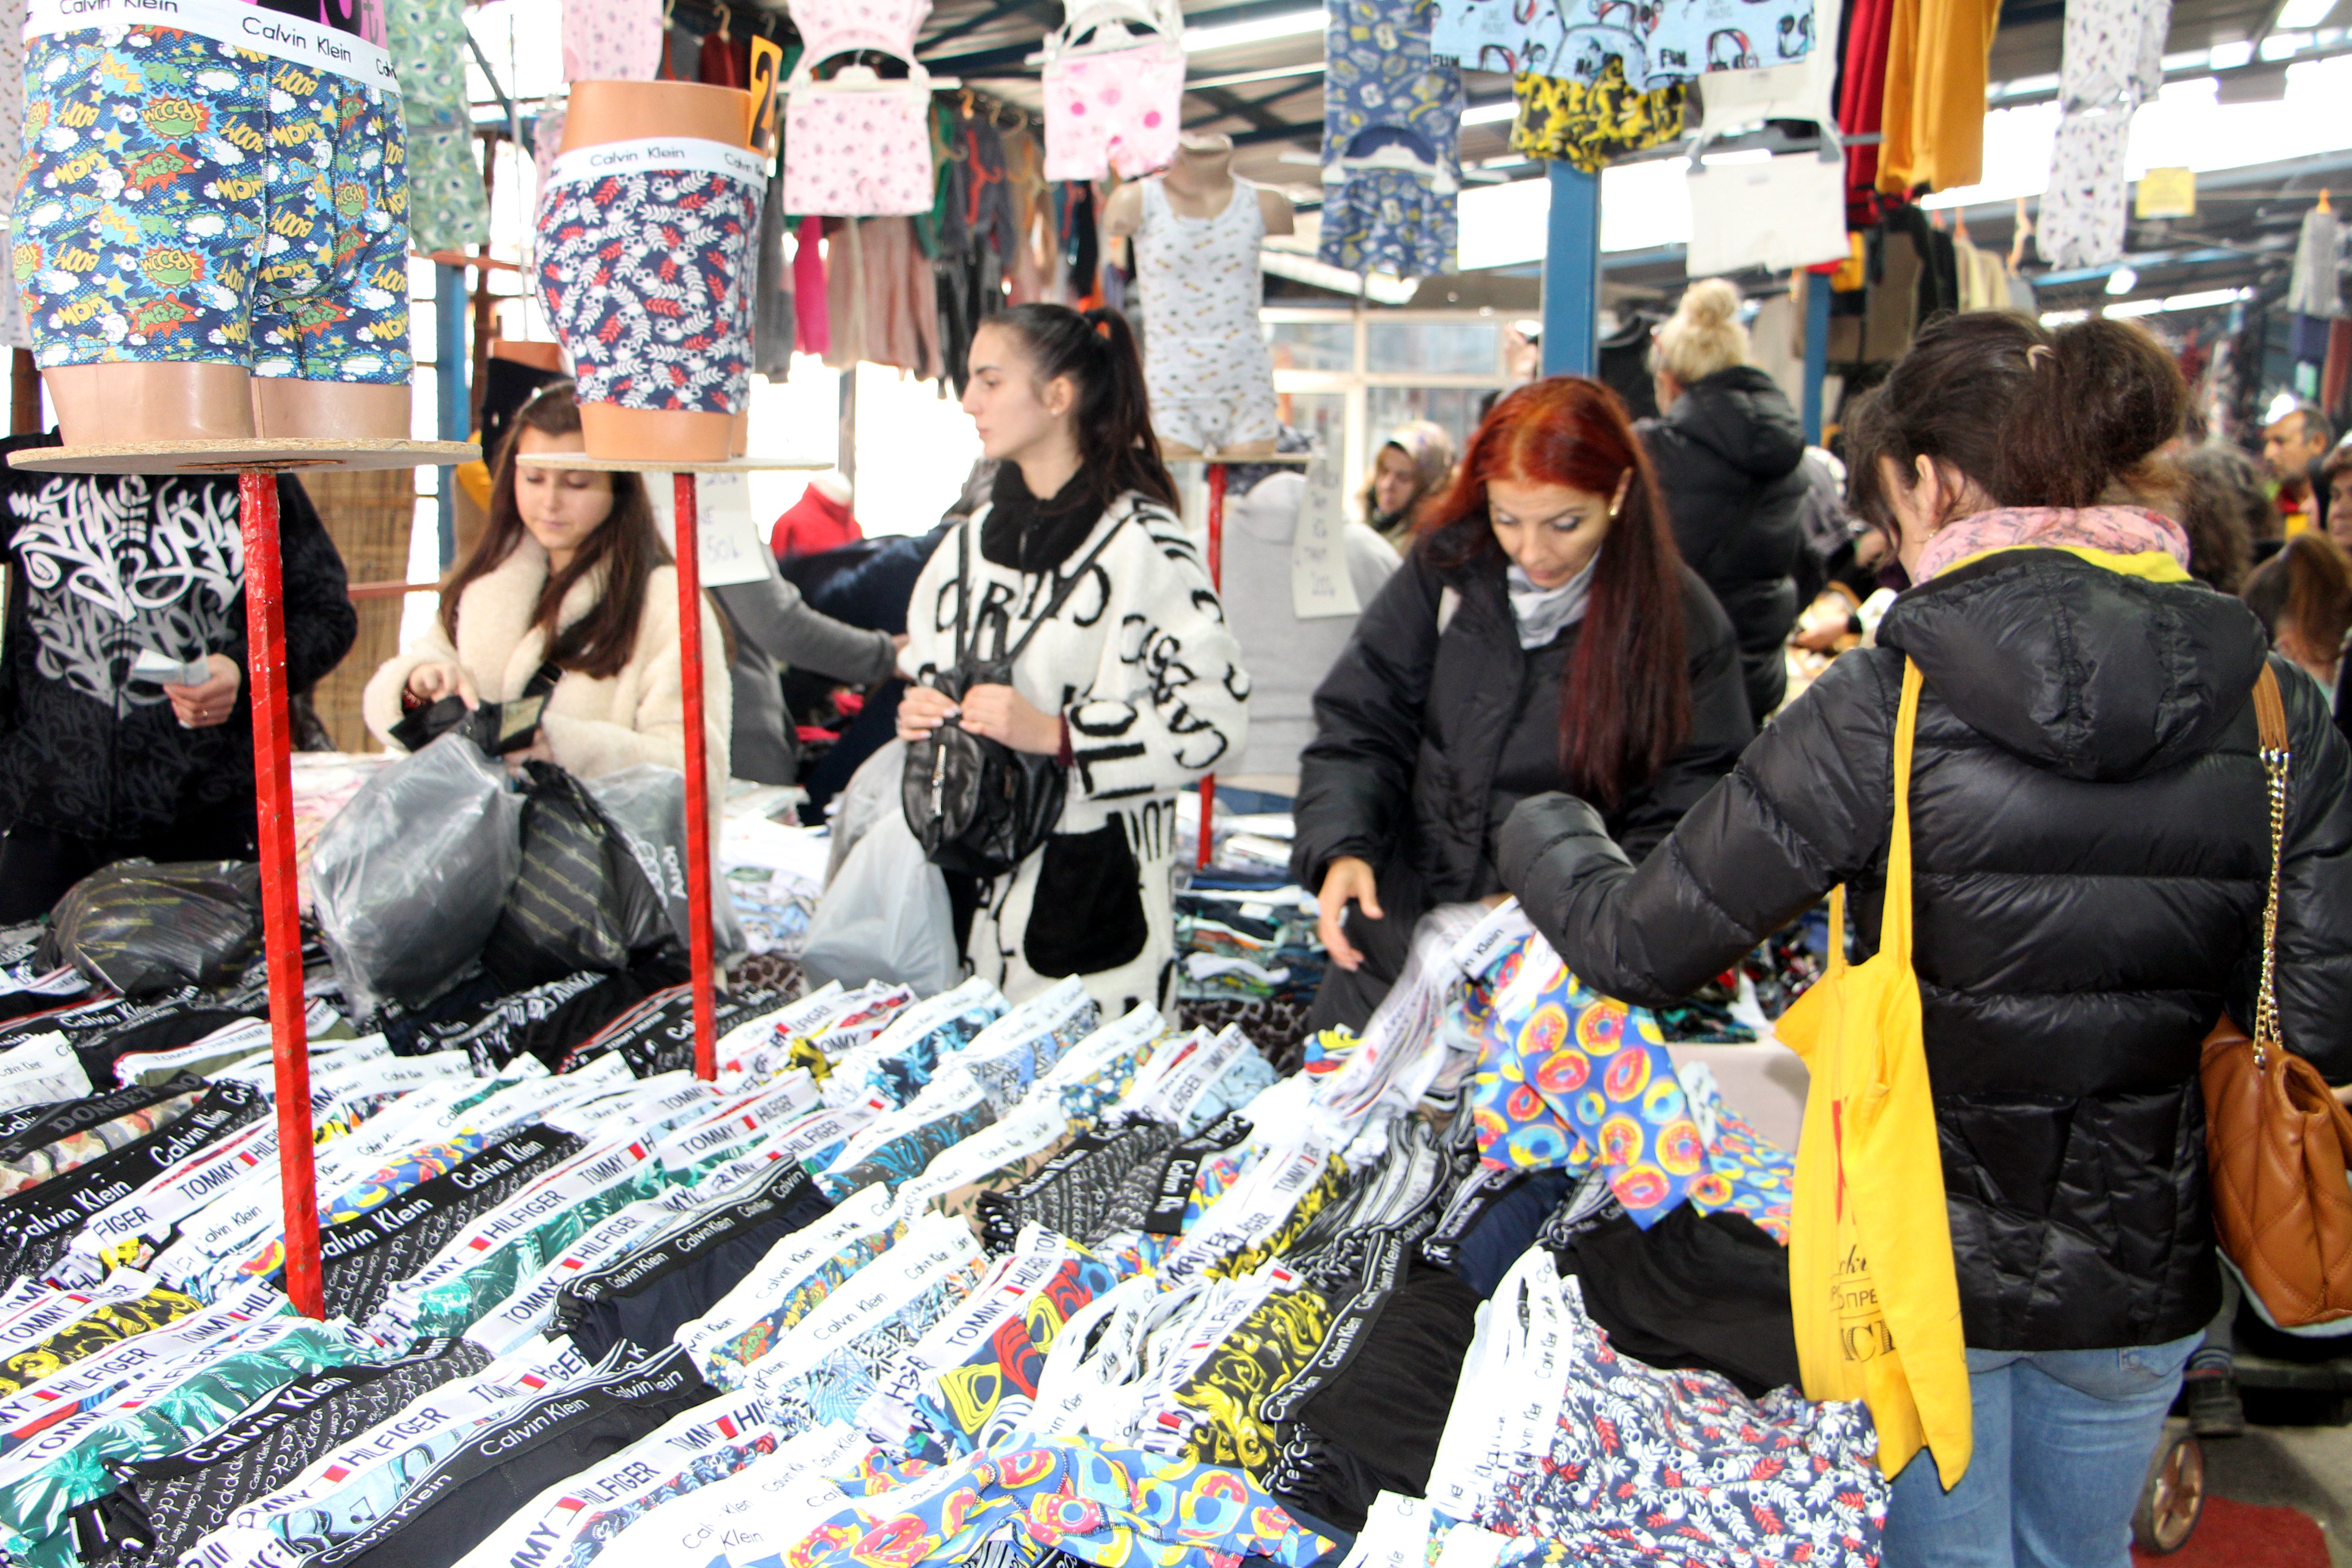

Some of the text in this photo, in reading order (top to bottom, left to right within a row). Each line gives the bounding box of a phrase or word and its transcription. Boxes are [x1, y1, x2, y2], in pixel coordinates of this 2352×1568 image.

[60, 0, 110, 14] Calvin
[242, 16, 306, 49] Calvin
[318, 35, 351, 63] Klein
[141, 99, 196, 123] BOOM
[591, 152, 638, 167] Calvin
[648, 147, 685, 159] Klein
[139, 249, 191, 274] BOOM
[1475, 927, 1505, 956] Klein
[59, 1012, 122, 1028] Calvin
[24, 1059, 44, 1071] Klein
[56, 1044, 74, 1057] Ca
[437, 1105, 459, 1129] Cal
[150, 1109, 232, 1168] Calvin Klein
[680, 1122, 738, 1156] TOMMY
[176, 1160, 241, 1201] TOMMY
[371, 1195, 433, 1234] Klein
[452, 1153, 514, 1191] Calvin
[502, 1140, 545, 1166] Klein
[1272, 1161, 1308, 1192] TOMMY
[72, 1178, 133, 1213] Klein
[482, 1190, 568, 1240] HILFIGER
[578, 1156, 628, 1188] TOMMY
[871, 1193, 897, 1217] Cal
[230, 1204, 263, 1228] Klein
[583, 1281, 603, 1302] ein
[606, 1264, 642, 1290] Calvin
[635, 1251, 670, 1276] Klein
[675, 1223, 716, 1253] Calvin
[708, 1216, 736, 1238] Klein
[771, 1170, 806, 1199] Calvin
[500, 1215, 647, 1326] TOMMY HILFIGER
[757, 1265, 794, 1299] Calvin
[789, 1247, 818, 1265] Klein
[813, 1312, 860, 1342] Calvin
[855, 1291, 888, 1313] Klein
[904, 1259, 932, 1280] Calvin
[0, 1304, 74, 1344] TOMMY
[945, 1299, 1009, 1347] TOMMY
[1335, 1317, 1364, 1343] Klein
[1318, 1338, 1354, 1368] Calvin
[50, 1348, 158, 1395] HILFIGER
[24, 1322, 285, 1460] TOMM TOMM
[1060, 1393, 1083, 1412] Klein
[0, 1403, 29, 1427] MY
[185, 1377, 352, 1463] Calvin Klein
[338, 1406, 451, 1467] HILFIGER
[813, 1429, 863, 1468] Calvin Klein
[321, 1519, 399, 1564] Calvin
[394, 1474, 452, 1518] Klein
[480, 1416, 550, 1456] Calvin
[546, 1397, 590, 1427] Klein
[576, 1460, 662, 1505] HILFIGER
[761, 1469, 793, 1492] Calvin
[170, 1521, 189, 1543] Klein
[720, 1528, 764, 1550] Klein
